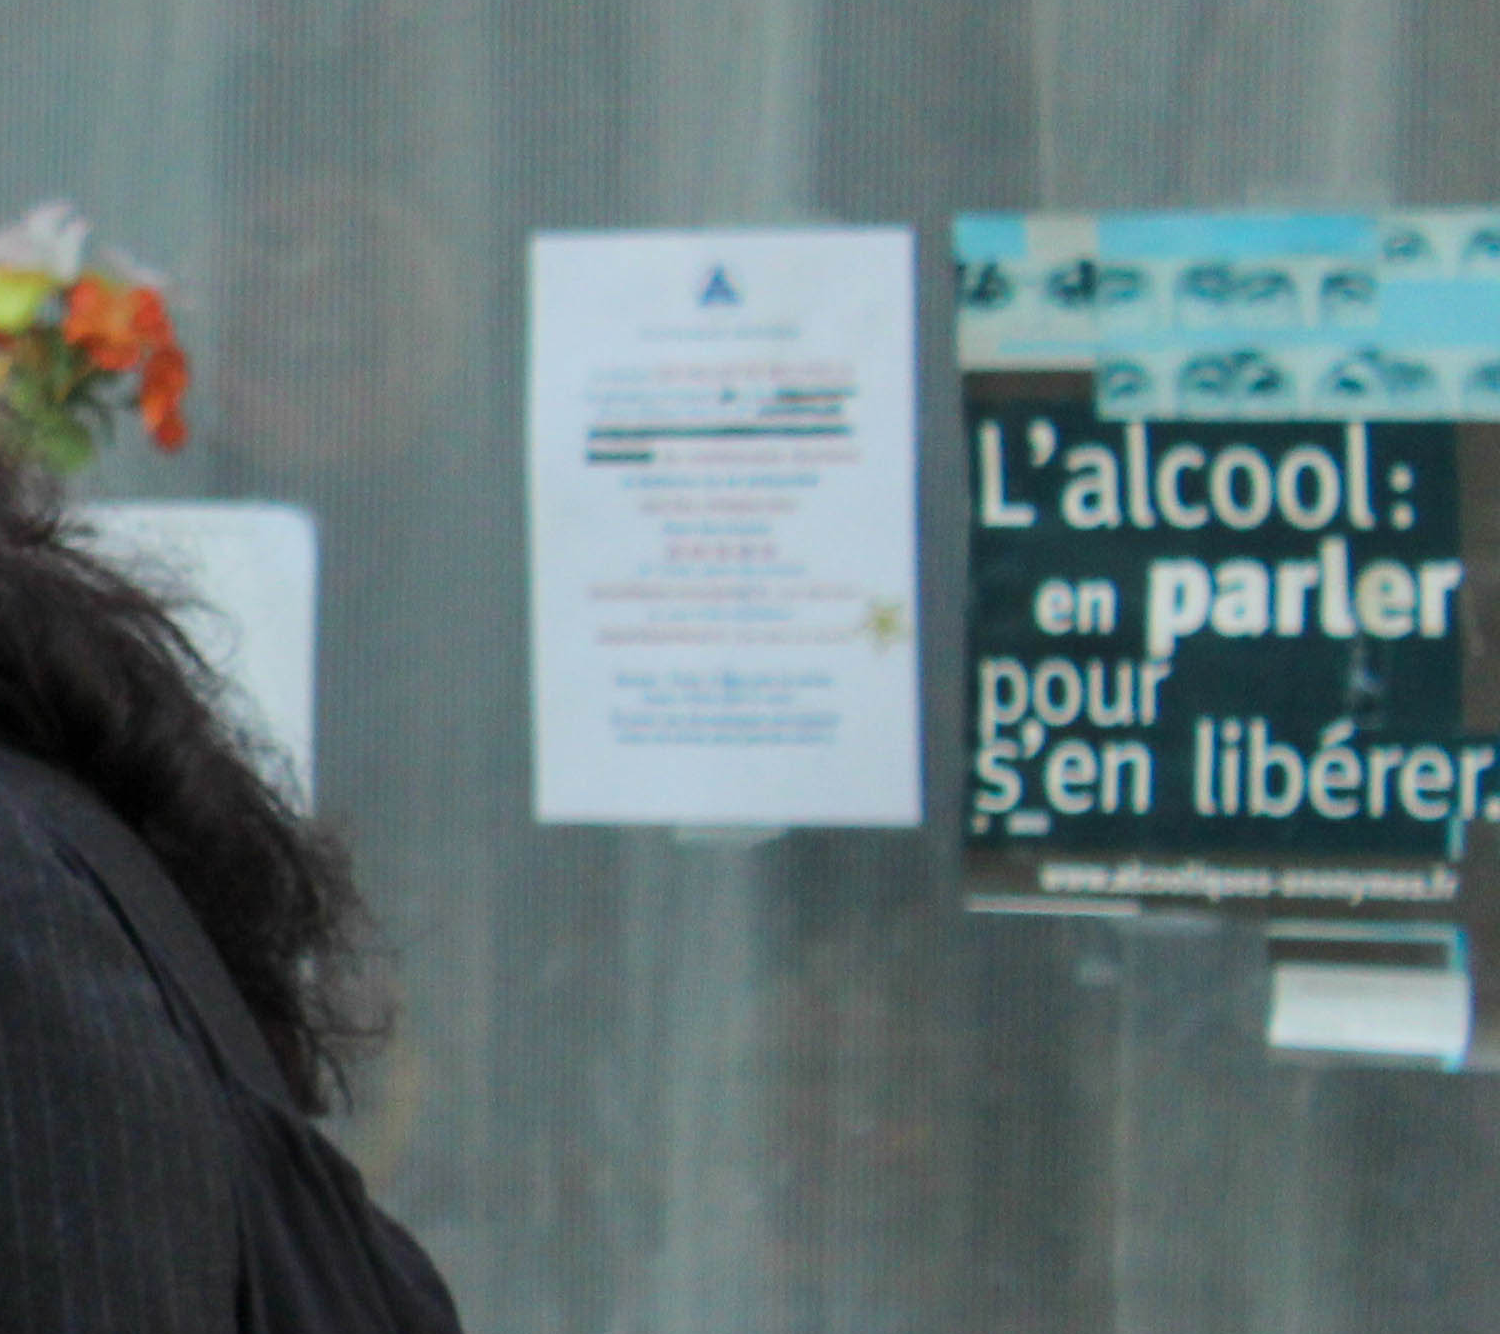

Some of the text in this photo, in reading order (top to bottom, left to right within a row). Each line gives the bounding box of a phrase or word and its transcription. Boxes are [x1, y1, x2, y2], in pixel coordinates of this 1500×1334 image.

[1034, 535, 1464, 659] en parler
[980, 657, 1172, 747] pour
[975, 717, 1500, 820] s'en libérer.
